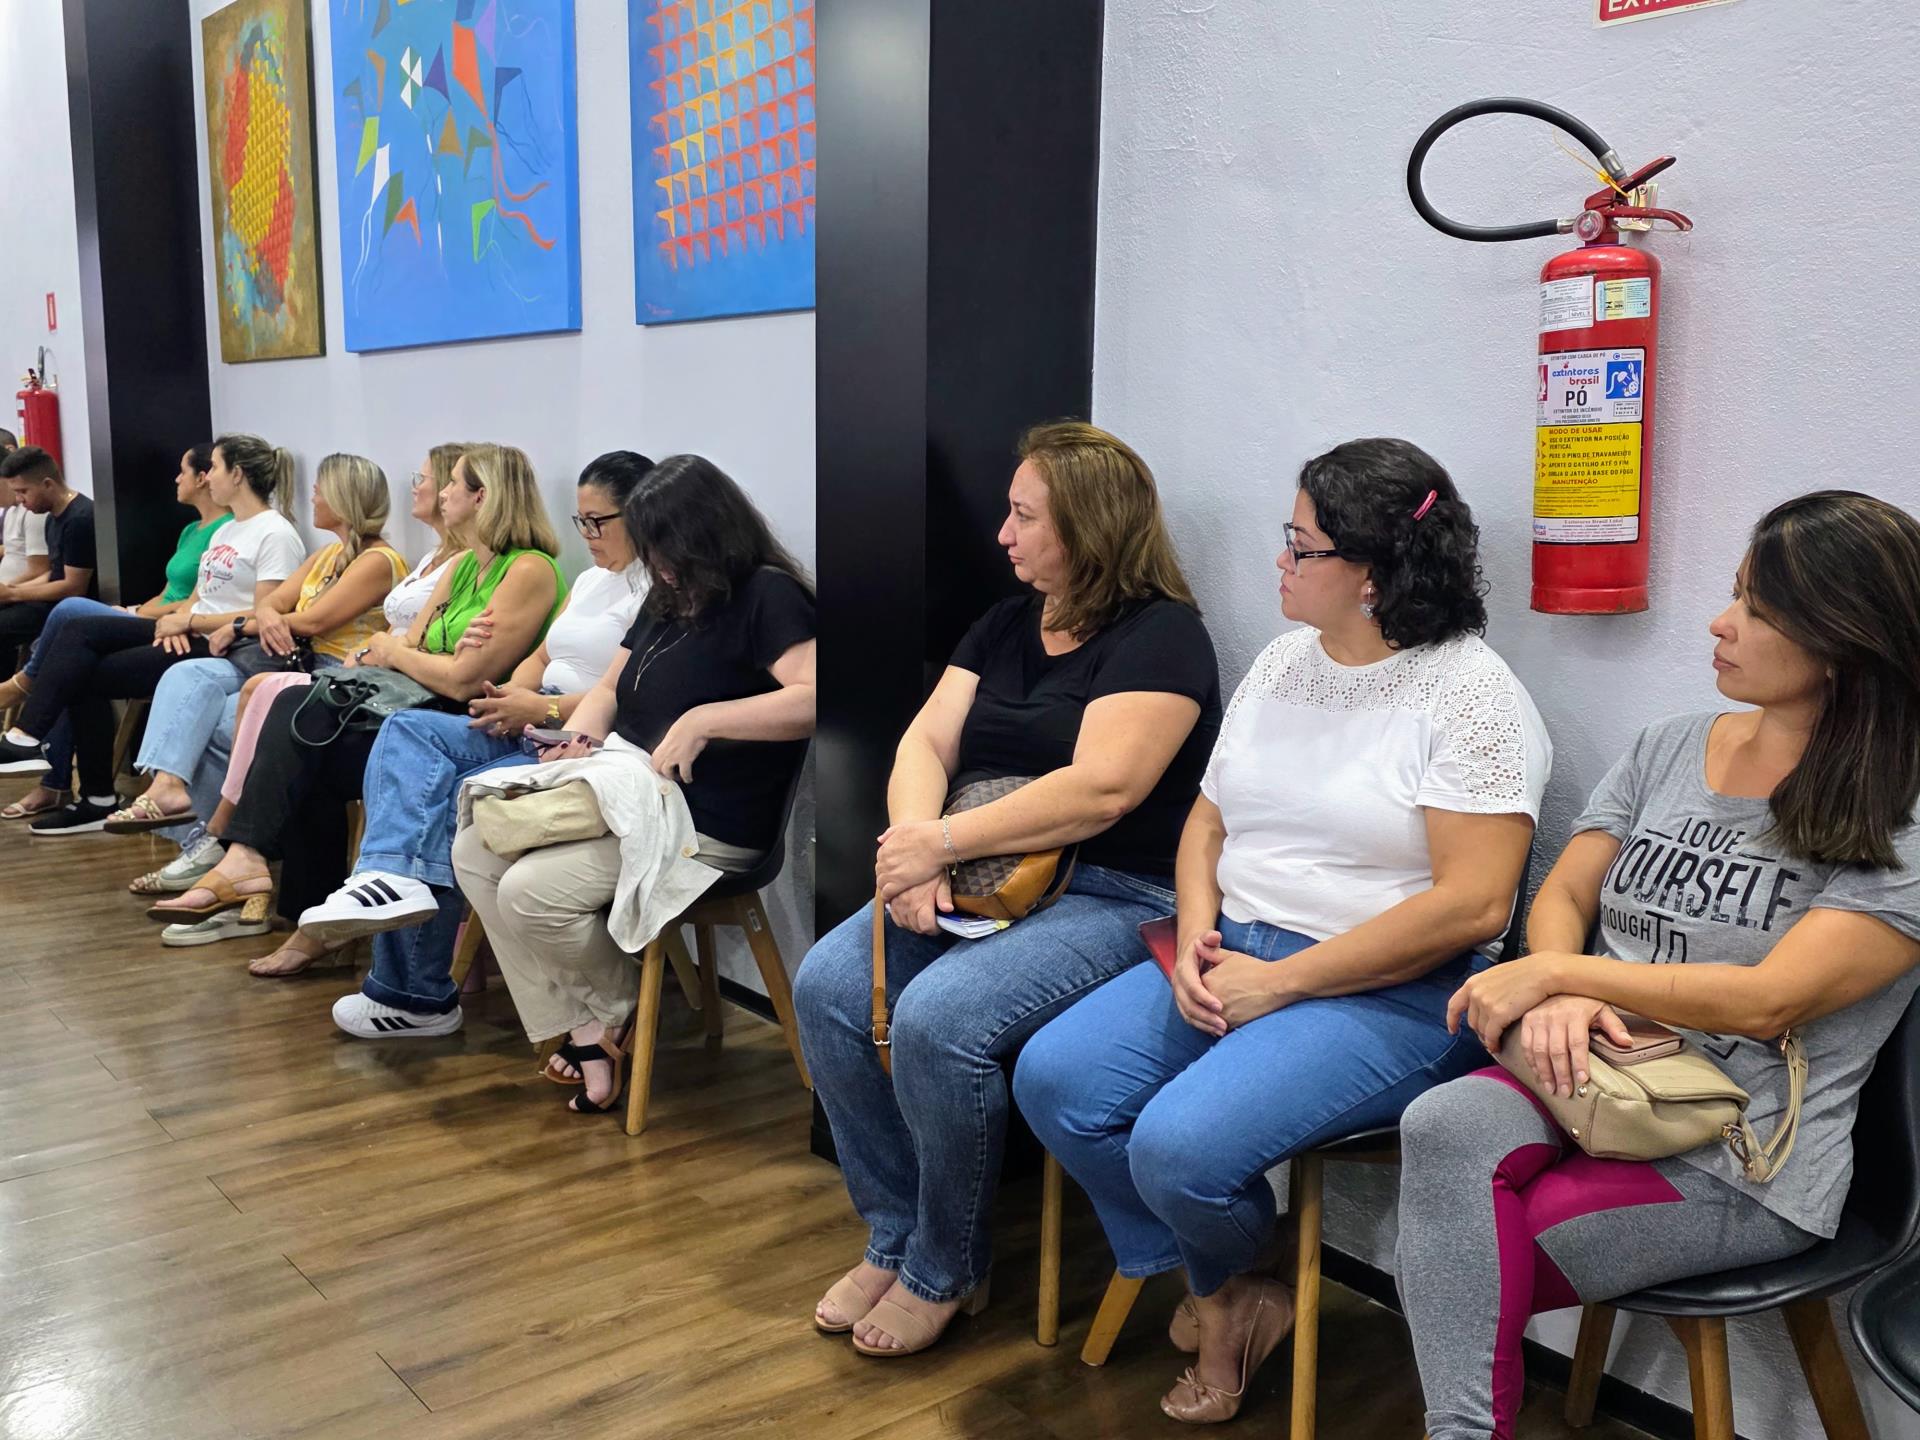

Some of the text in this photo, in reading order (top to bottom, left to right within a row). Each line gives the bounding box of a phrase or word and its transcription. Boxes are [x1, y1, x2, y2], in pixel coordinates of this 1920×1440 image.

[1552, 367, 1600, 377] extintores
[1569, 376, 1600, 385] brasil
[1566, 385, 1588, 407] PÓ
[1677, 817, 1746, 855] LOVE
[1604, 834, 1801, 932] YOURSELF
[1600, 904, 1650, 942] NOUGH
